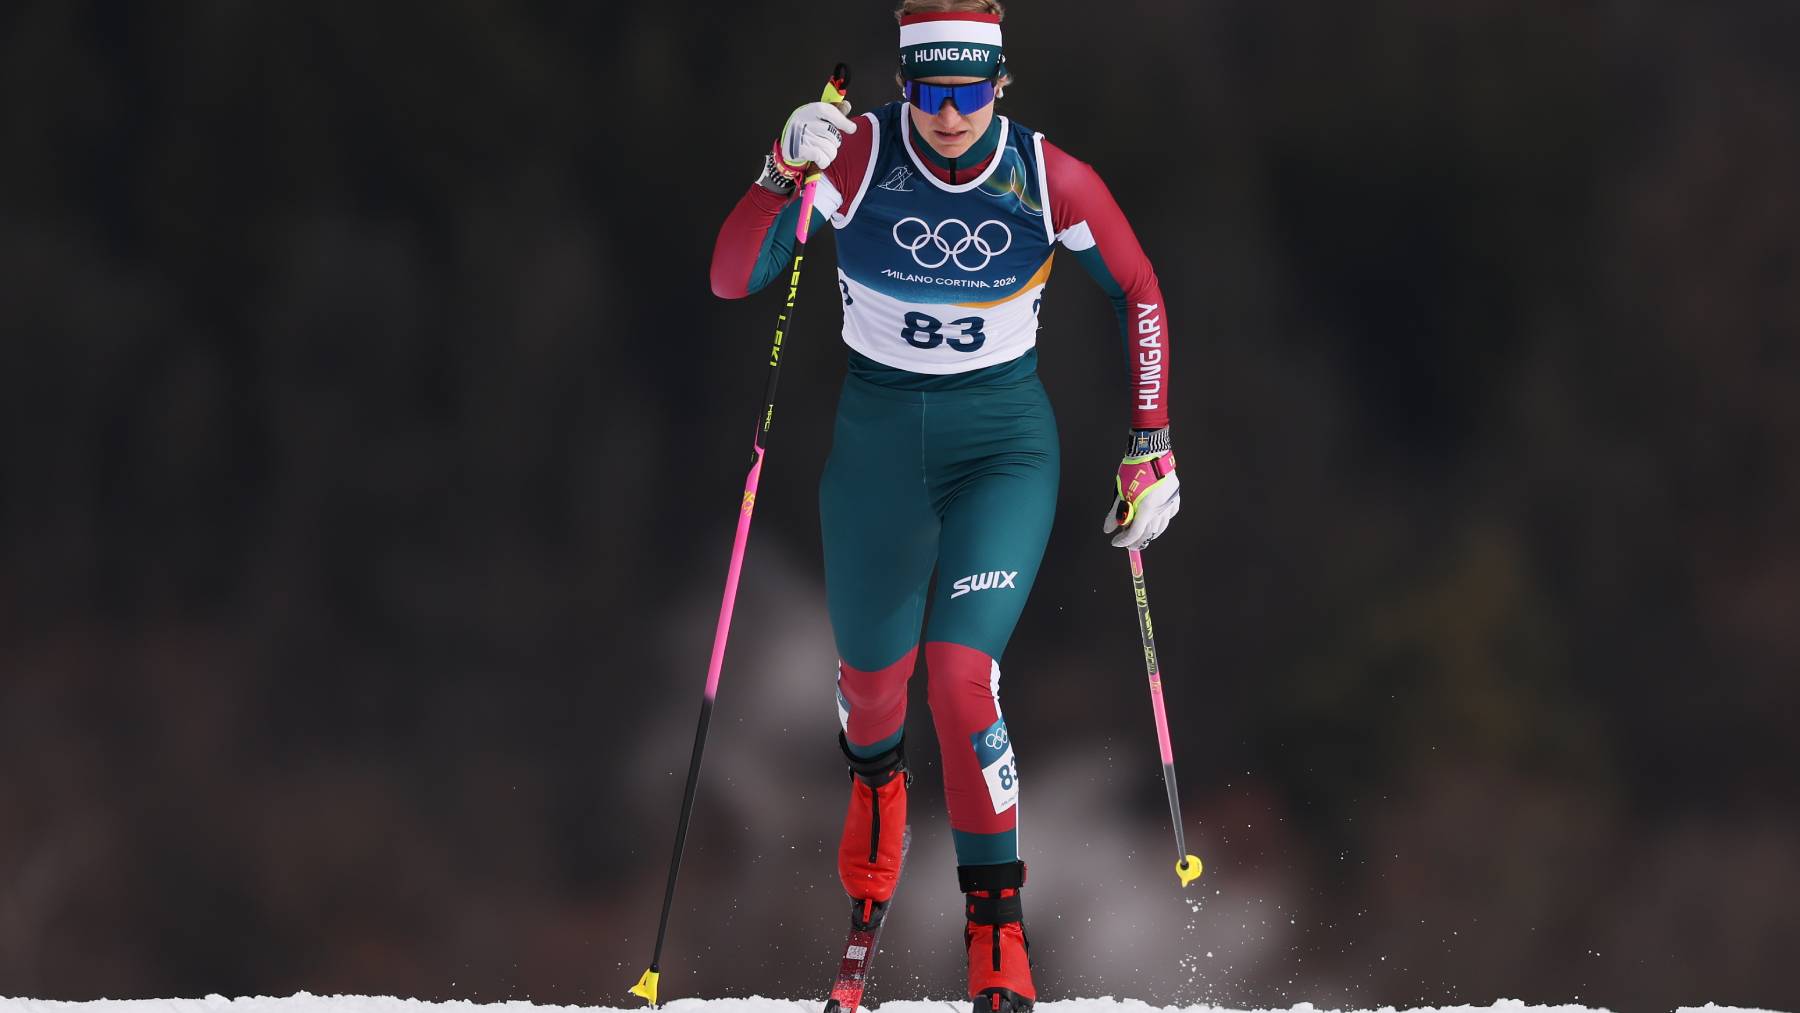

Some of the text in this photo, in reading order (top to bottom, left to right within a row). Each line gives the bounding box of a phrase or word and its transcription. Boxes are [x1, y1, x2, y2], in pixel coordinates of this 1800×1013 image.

[915, 48, 990, 63] HUNGARY
[786, 256, 804, 307] LEKI
[881, 269, 1017, 289] MILANO CORTINA 2026
[770, 315, 786, 367] LEKI
[900, 311, 986, 353] 83
[1137, 303, 1160, 410] HUNGARY
[951, 570, 1018, 600] SWIX
